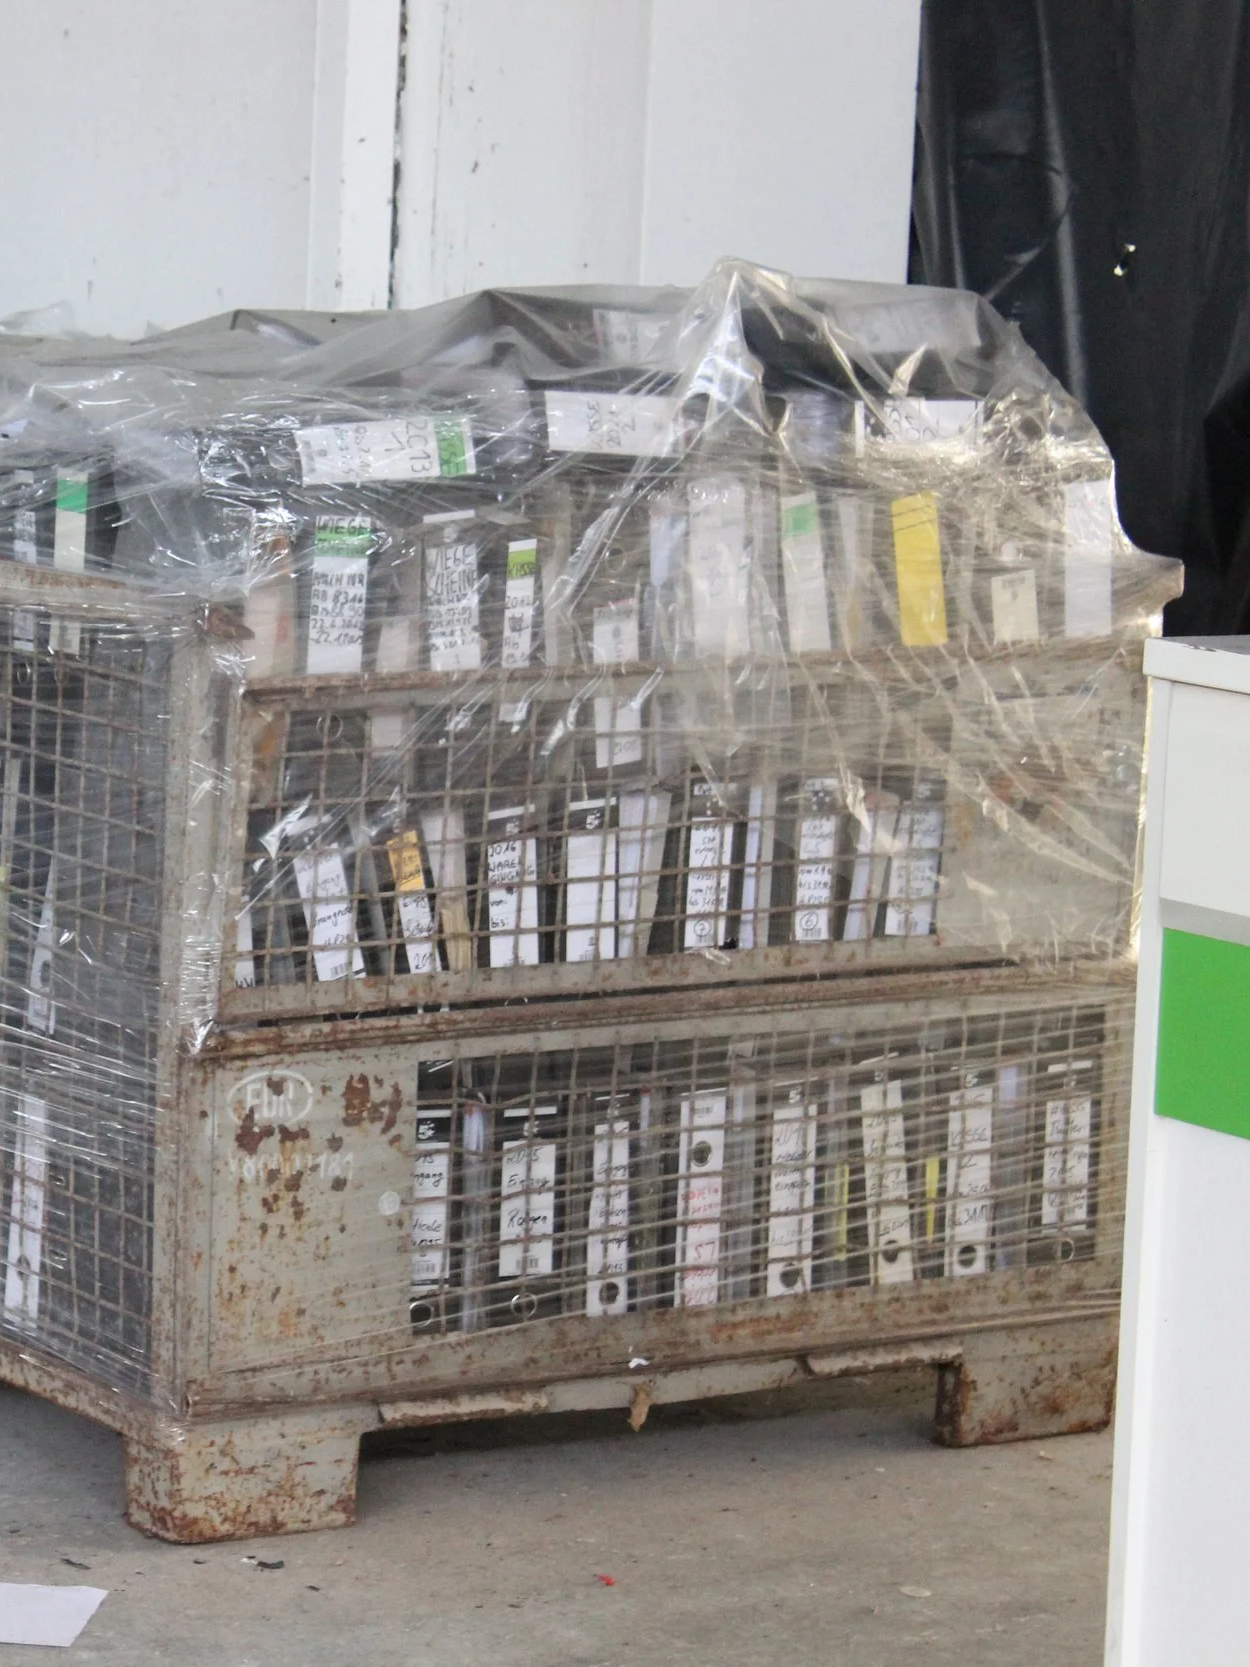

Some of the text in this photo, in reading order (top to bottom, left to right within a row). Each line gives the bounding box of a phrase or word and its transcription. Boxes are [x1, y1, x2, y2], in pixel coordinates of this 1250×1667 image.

[405, 418, 434, 474] 2013
[488, 858, 522, 874] WARE
[413, 1172, 444, 1188] ngang
